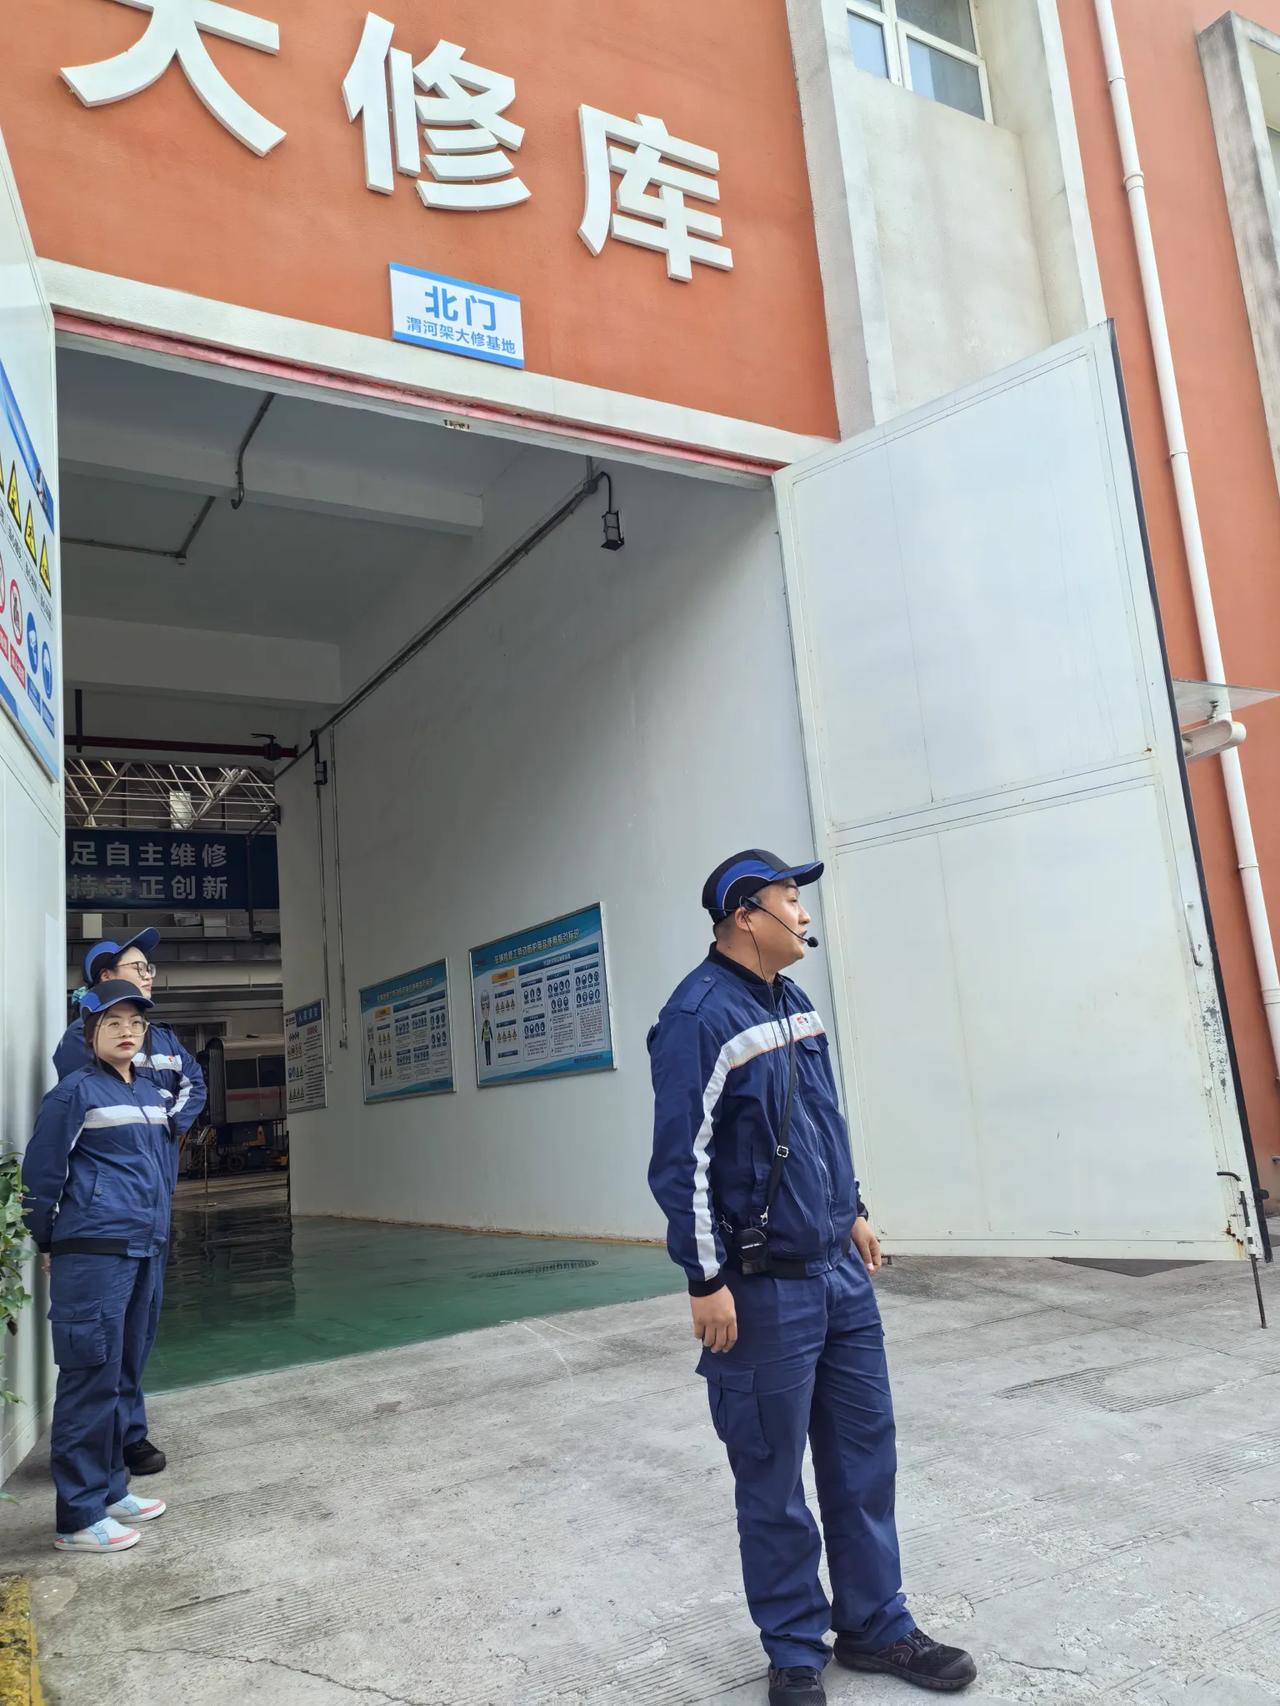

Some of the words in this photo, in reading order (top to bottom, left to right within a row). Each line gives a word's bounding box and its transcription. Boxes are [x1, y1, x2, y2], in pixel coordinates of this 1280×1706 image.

[59, 0, 735, 282] 大修库
[424, 285, 497, 331] 北门
[406, 316, 517, 355] 渭河架大修基地
[70, 841, 228, 868] 足自主维修
[70, 874, 229, 900] 持守正创新
